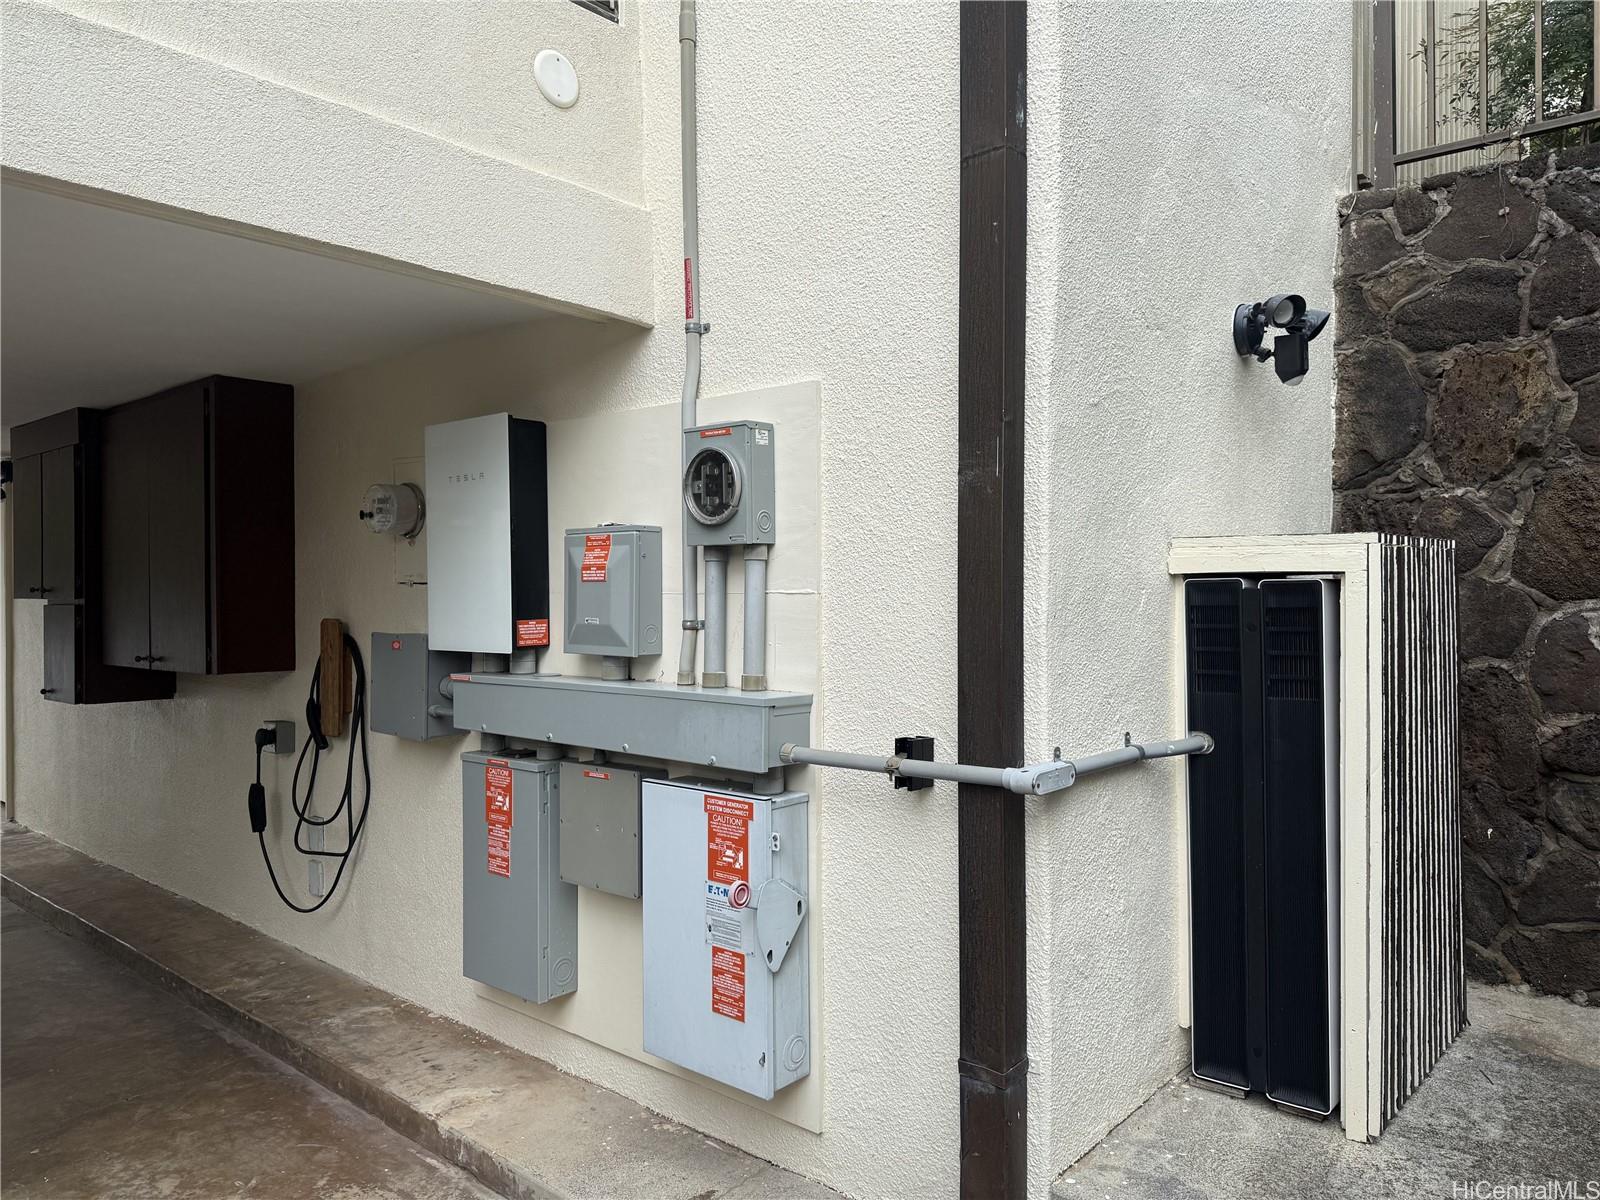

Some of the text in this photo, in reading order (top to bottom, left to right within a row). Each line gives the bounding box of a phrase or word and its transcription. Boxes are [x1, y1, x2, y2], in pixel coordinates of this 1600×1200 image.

[448, 472, 486, 484] TESLA
[707, 798, 749, 809] CUSTOMER GENERATOR
[707, 804, 749, 816] SYSTEM DISCONNECT
[712, 814, 743, 826] CAUTION!
